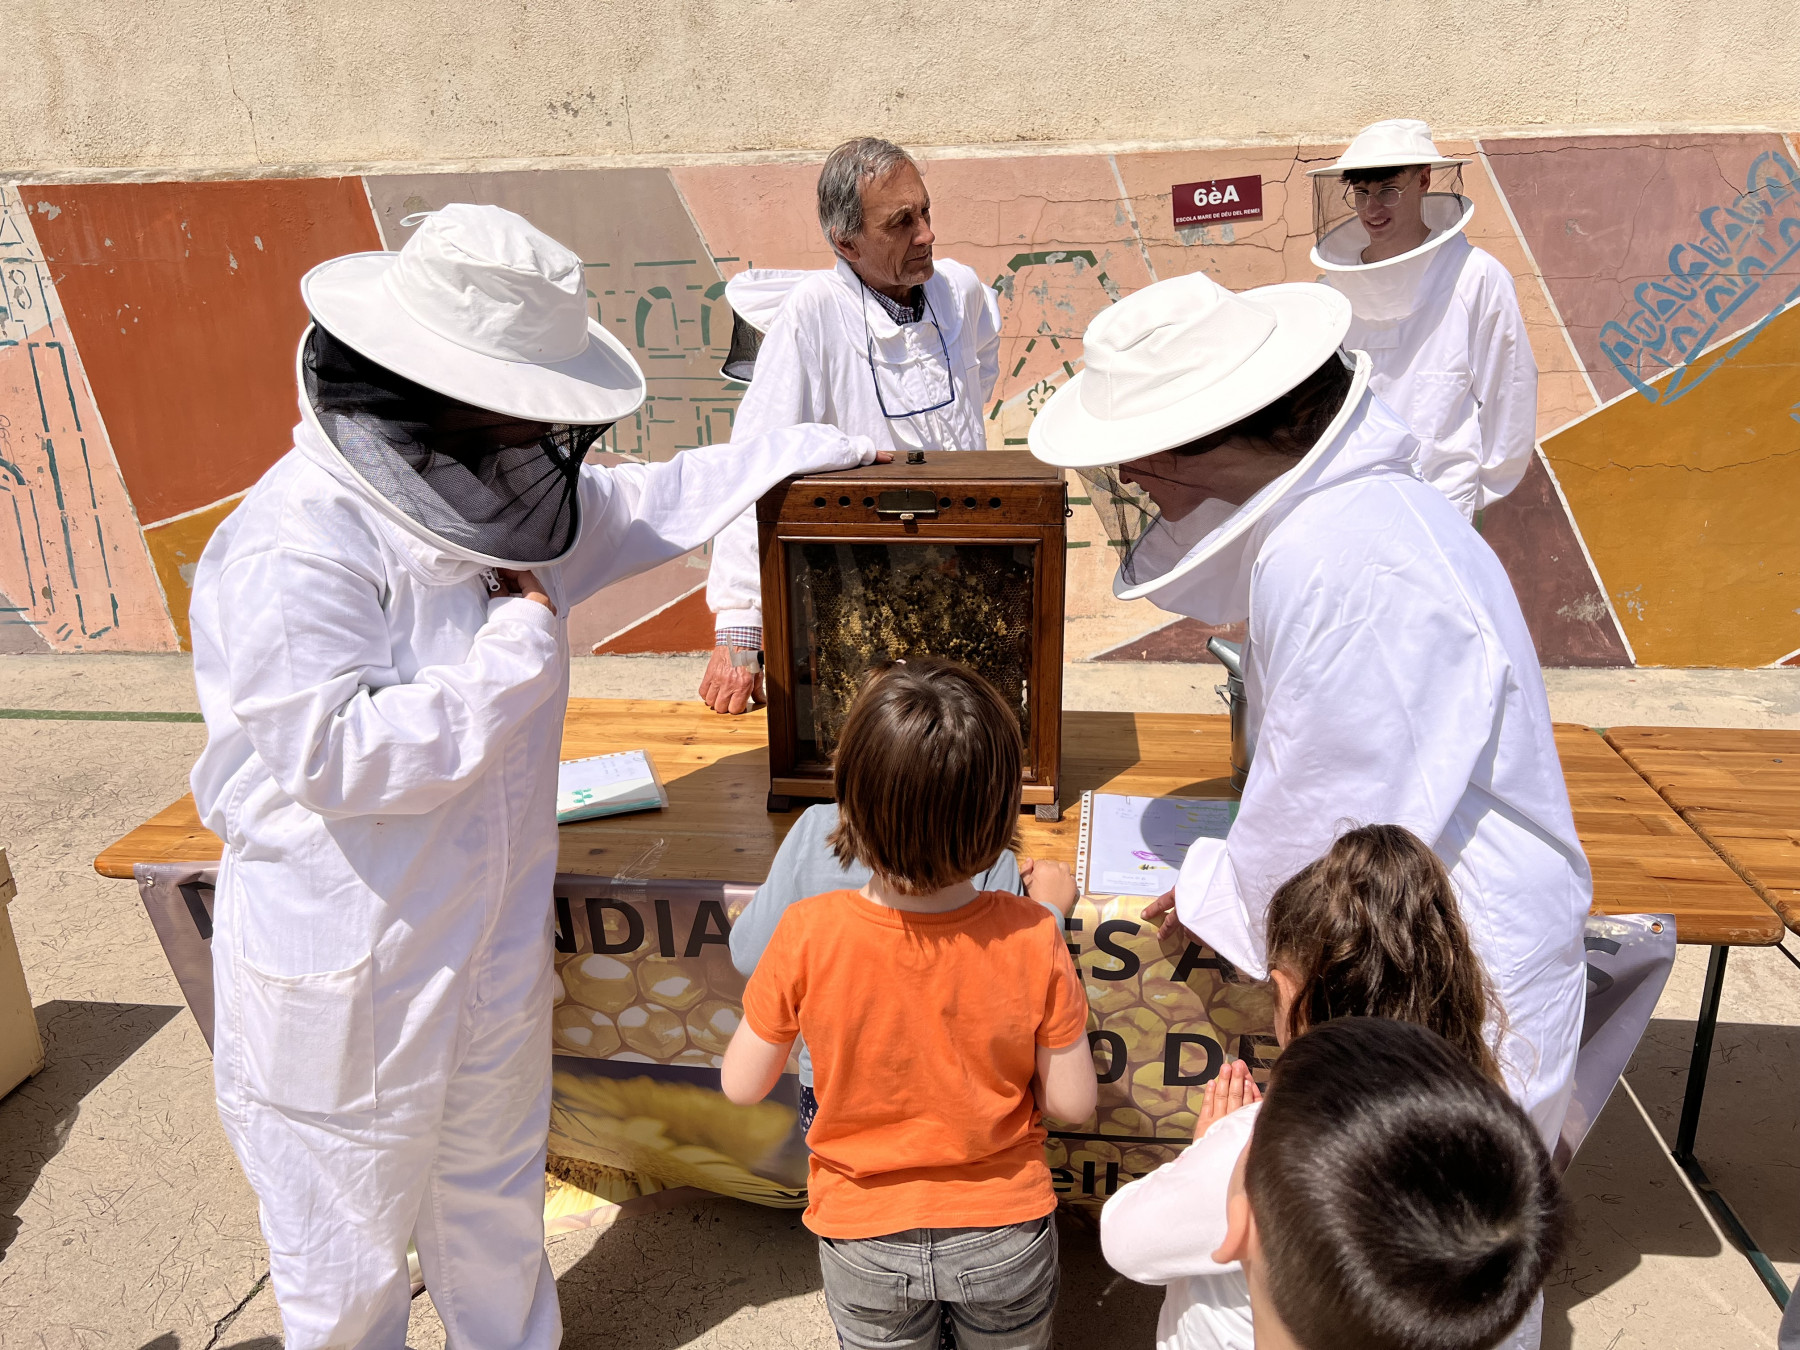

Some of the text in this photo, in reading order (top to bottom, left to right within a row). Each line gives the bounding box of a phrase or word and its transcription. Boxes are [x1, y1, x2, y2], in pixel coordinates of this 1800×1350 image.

[1193, 185, 1240, 207] 6èA
[1175, 215, 1197, 223] ESCOLA
[1197, 213, 1212, 221] MARE
[1050, 1161, 1148, 1196] ell
